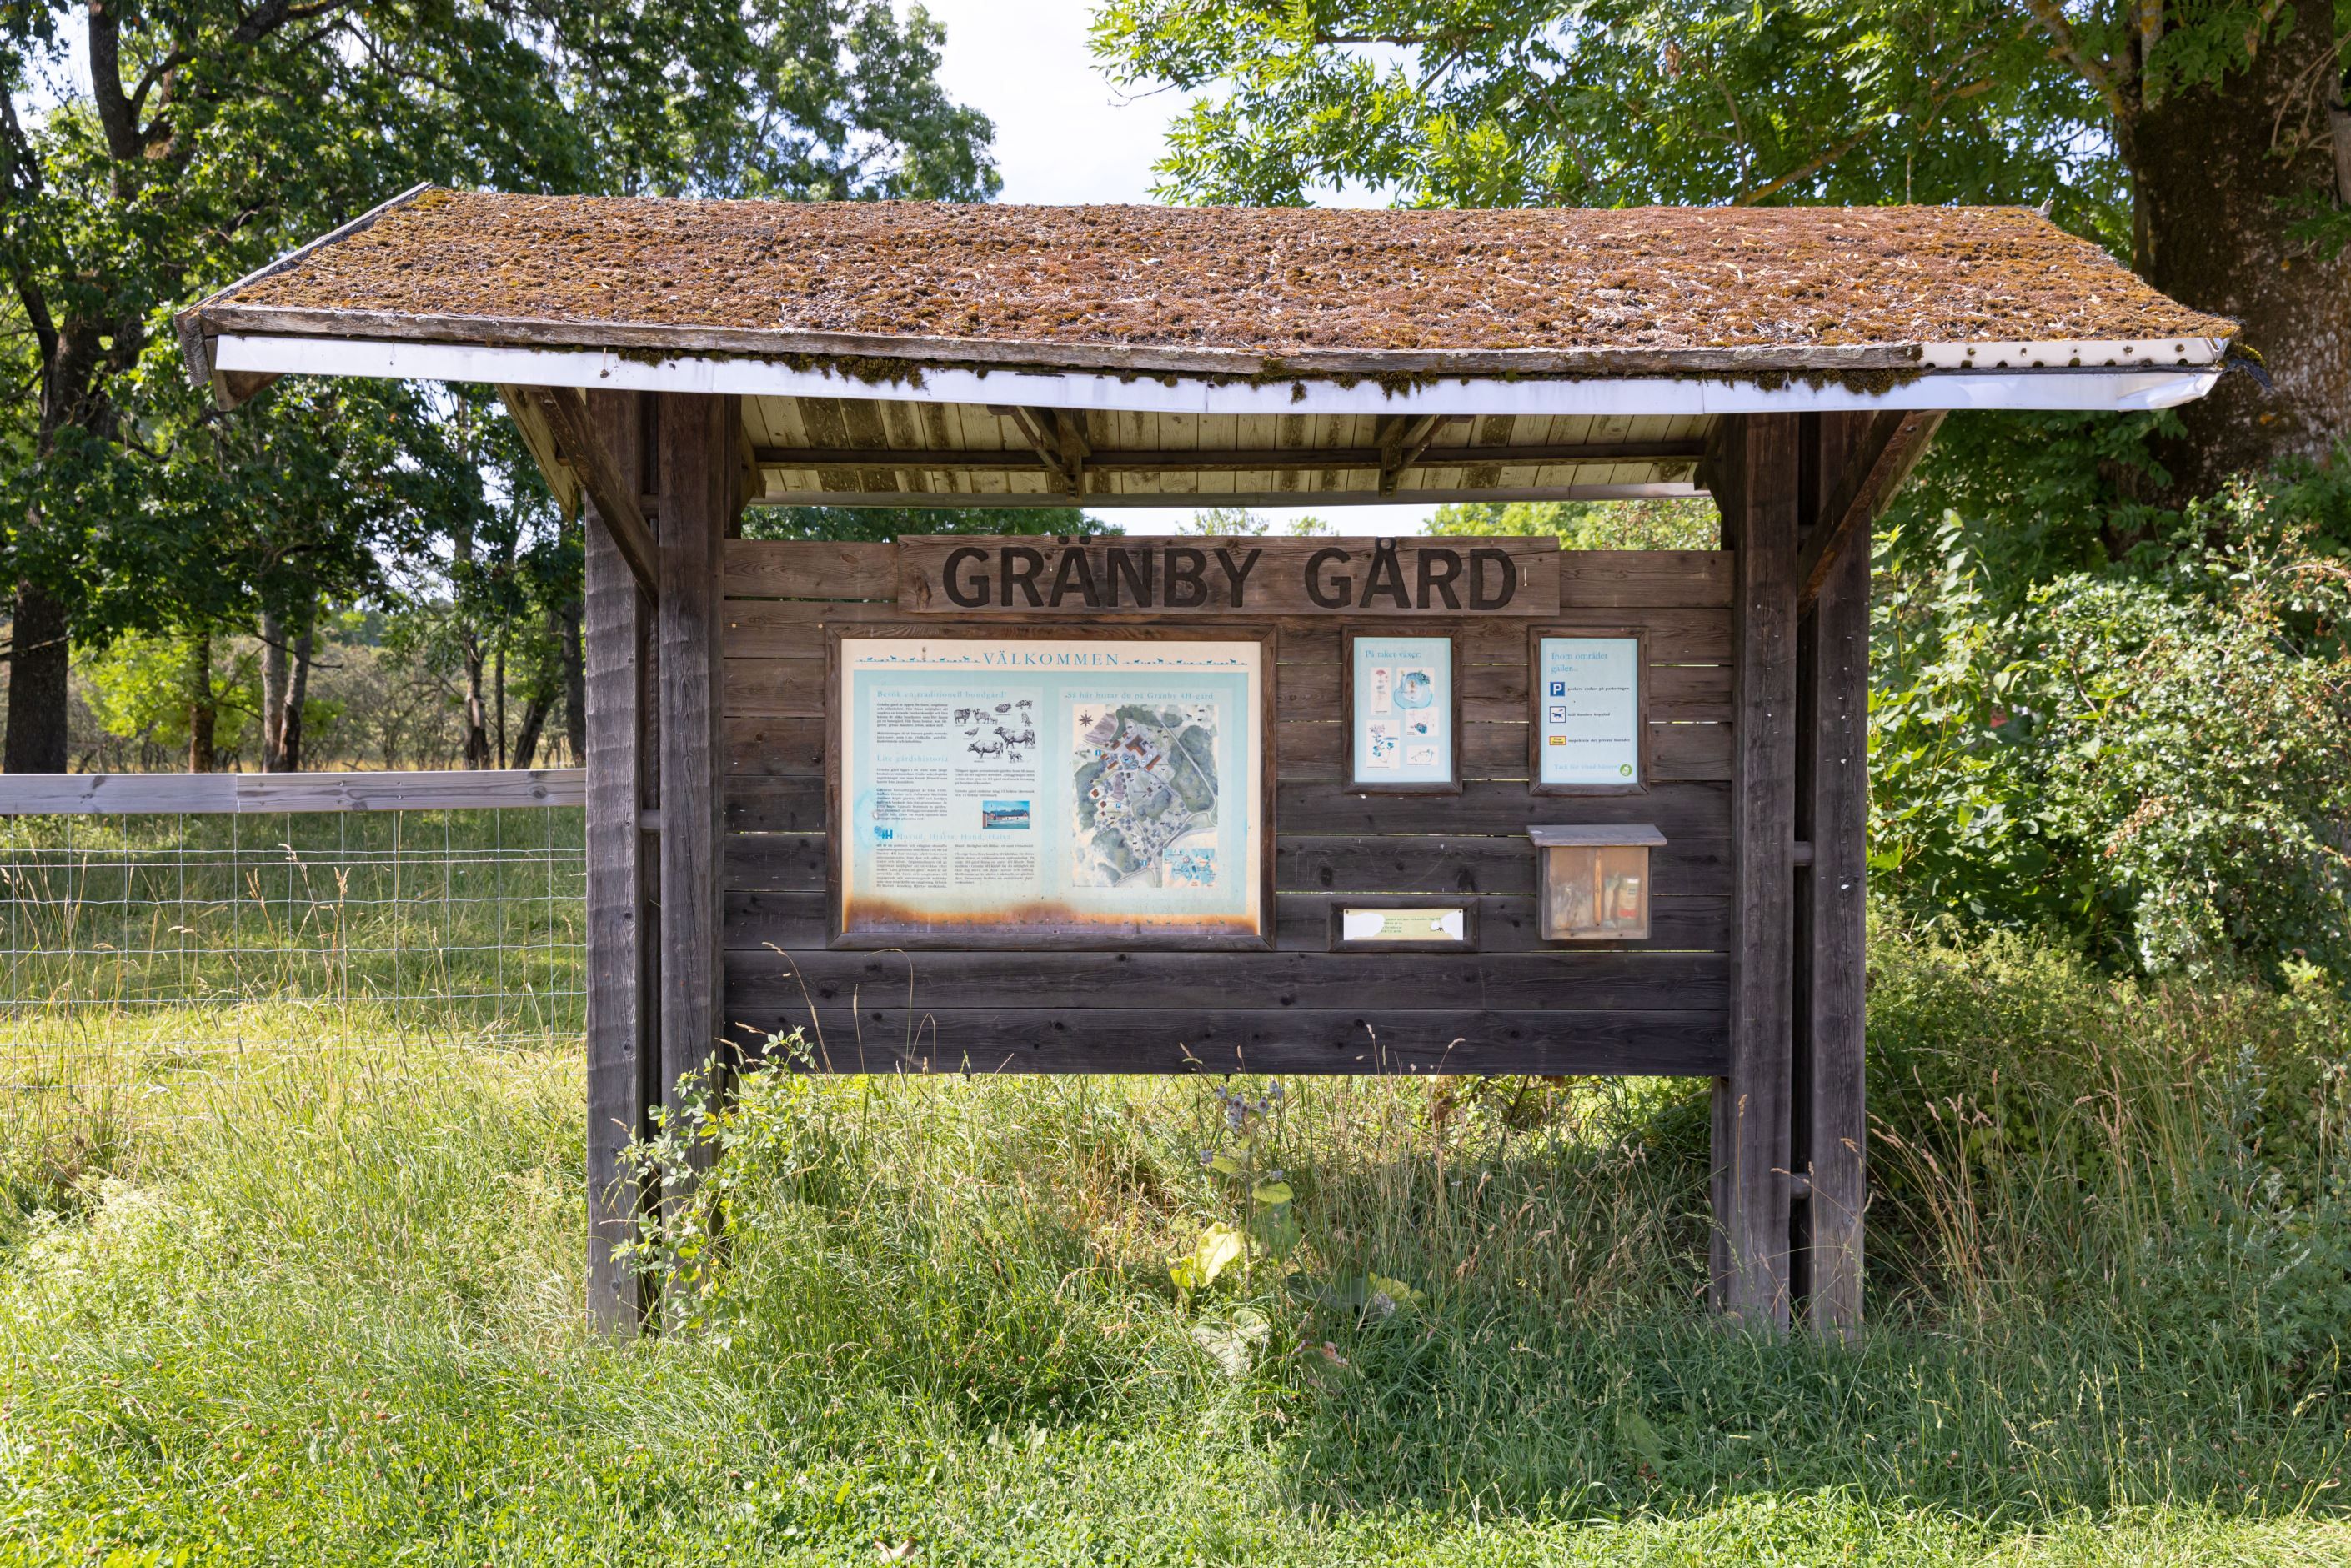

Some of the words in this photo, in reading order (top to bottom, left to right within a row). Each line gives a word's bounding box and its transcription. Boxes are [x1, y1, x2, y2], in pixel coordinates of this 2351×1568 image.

[943, 535, 1262, 609] GRÄNBY
[1305, 536, 1517, 610] GÅRD
[983, 650, 1120, 666] VÄLKOMMEN
[1551, 652, 1572, 660] Inom
[1575, 651, 1608, 660] området
